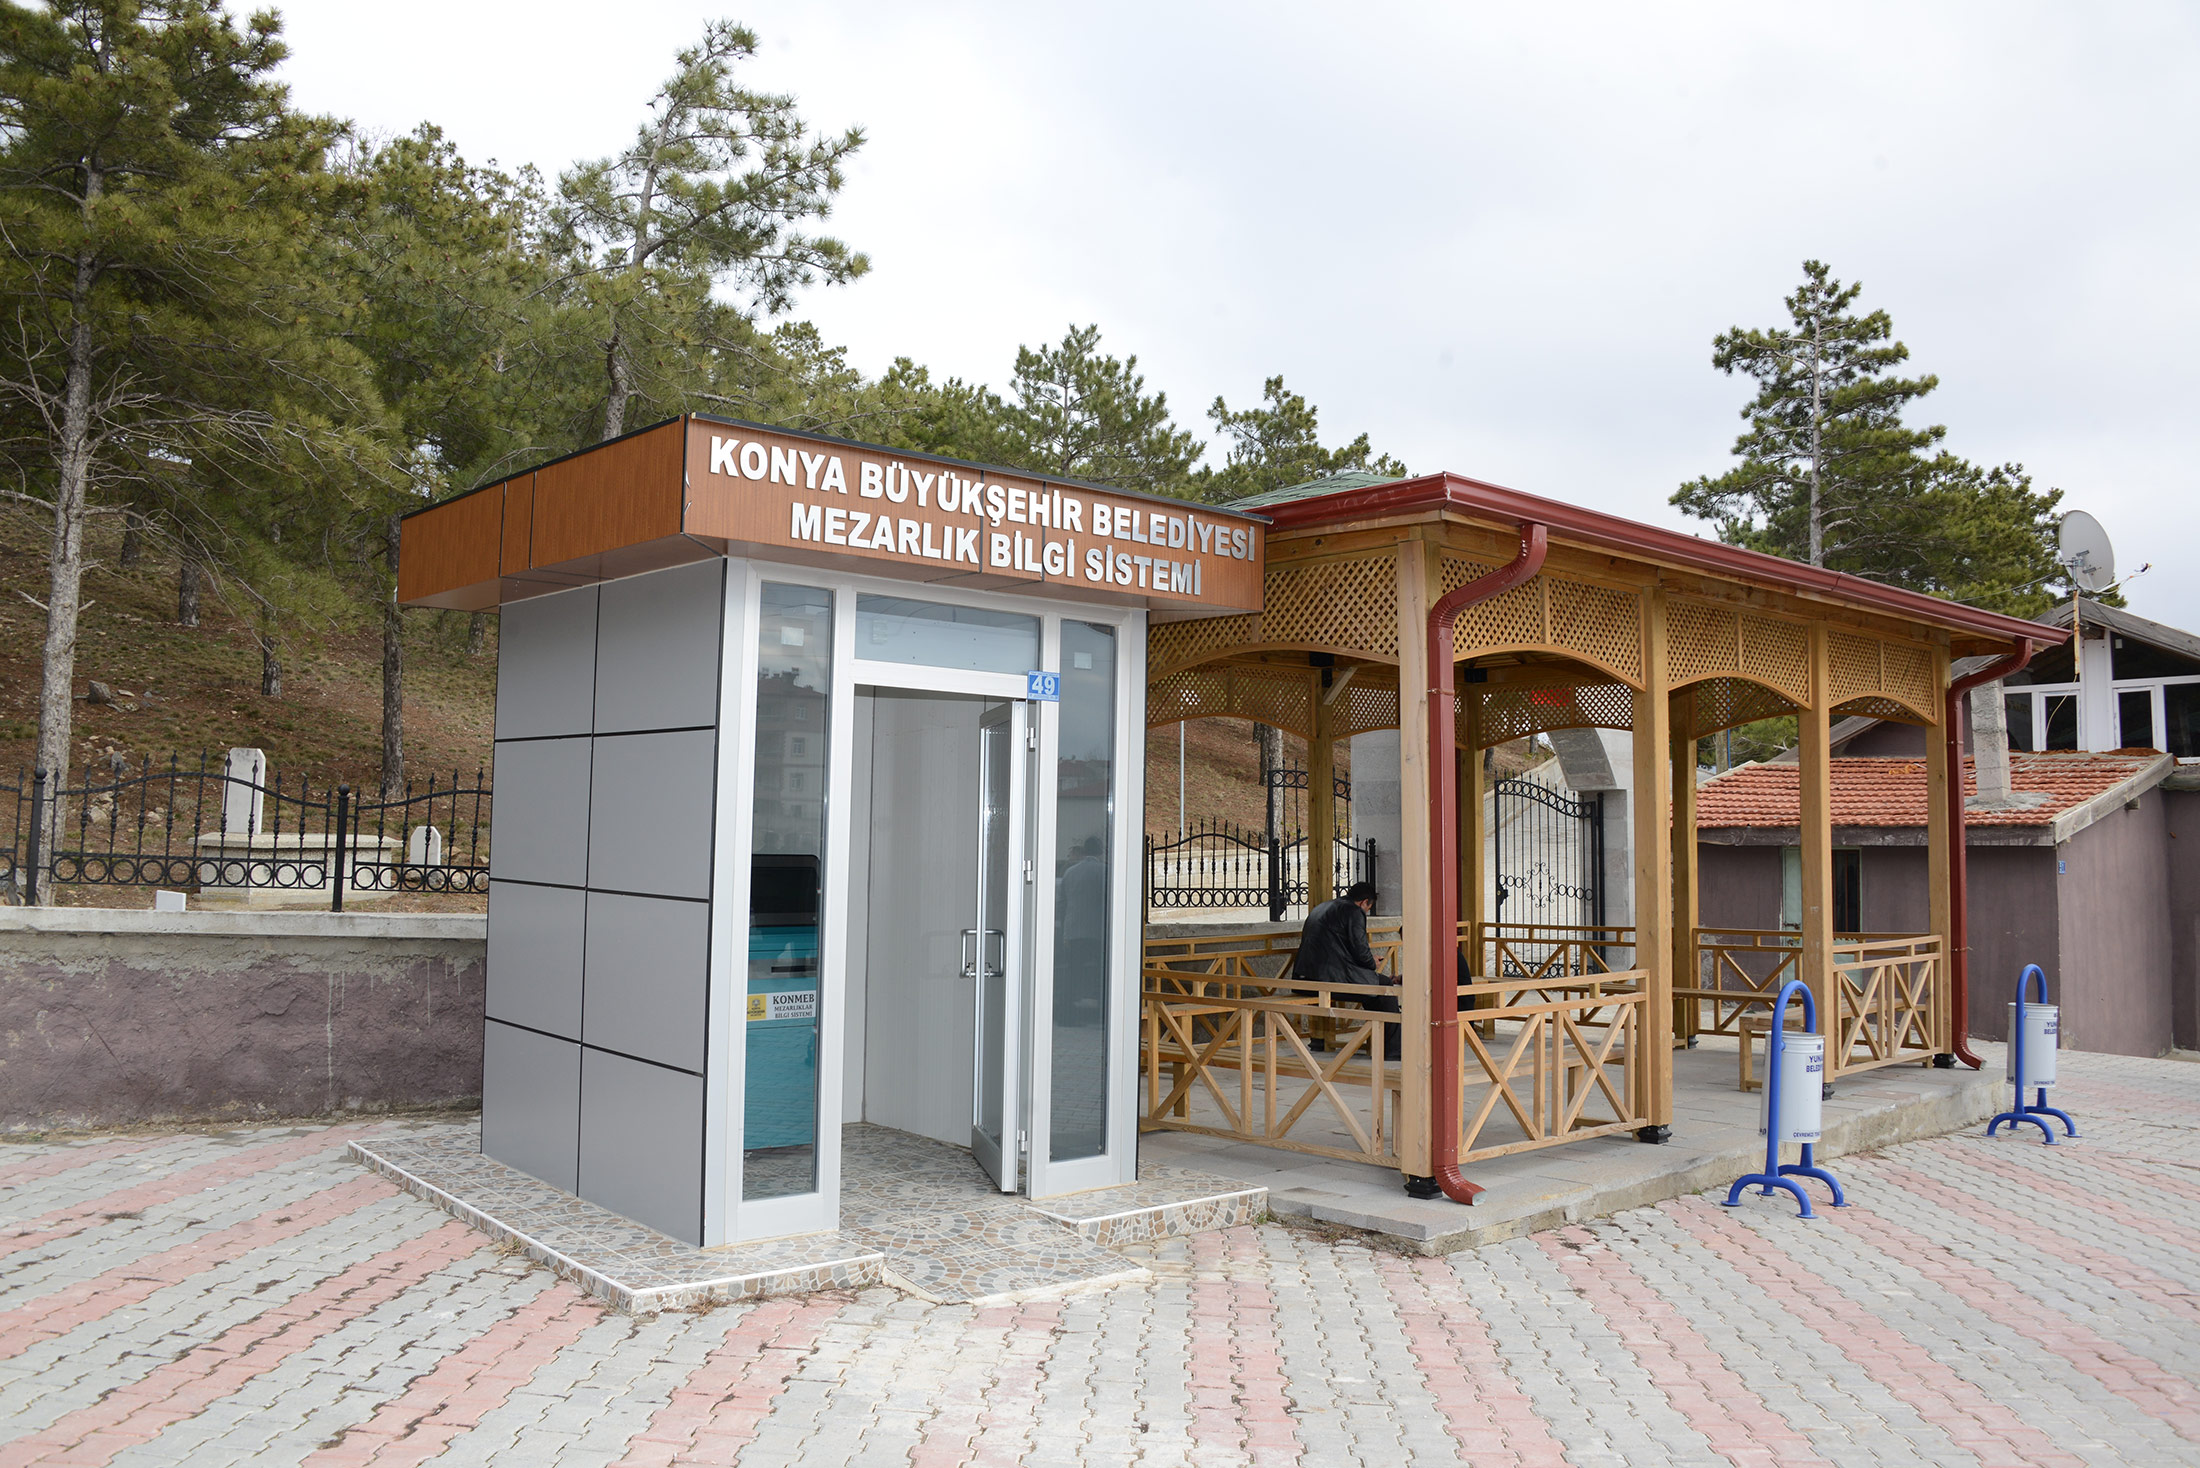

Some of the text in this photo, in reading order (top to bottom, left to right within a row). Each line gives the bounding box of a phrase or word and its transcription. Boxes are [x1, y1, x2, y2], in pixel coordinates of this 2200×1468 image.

[710, 436, 1256, 562] KONYA BÜYÜKŞEHİR BELEDİYESİ
[791, 502, 1202, 596] MEZARLIK BİLGİ SİSTEMİ
[1032, 675, 1055, 695] 49
[773, 994, 815, 1005] KONMEB
